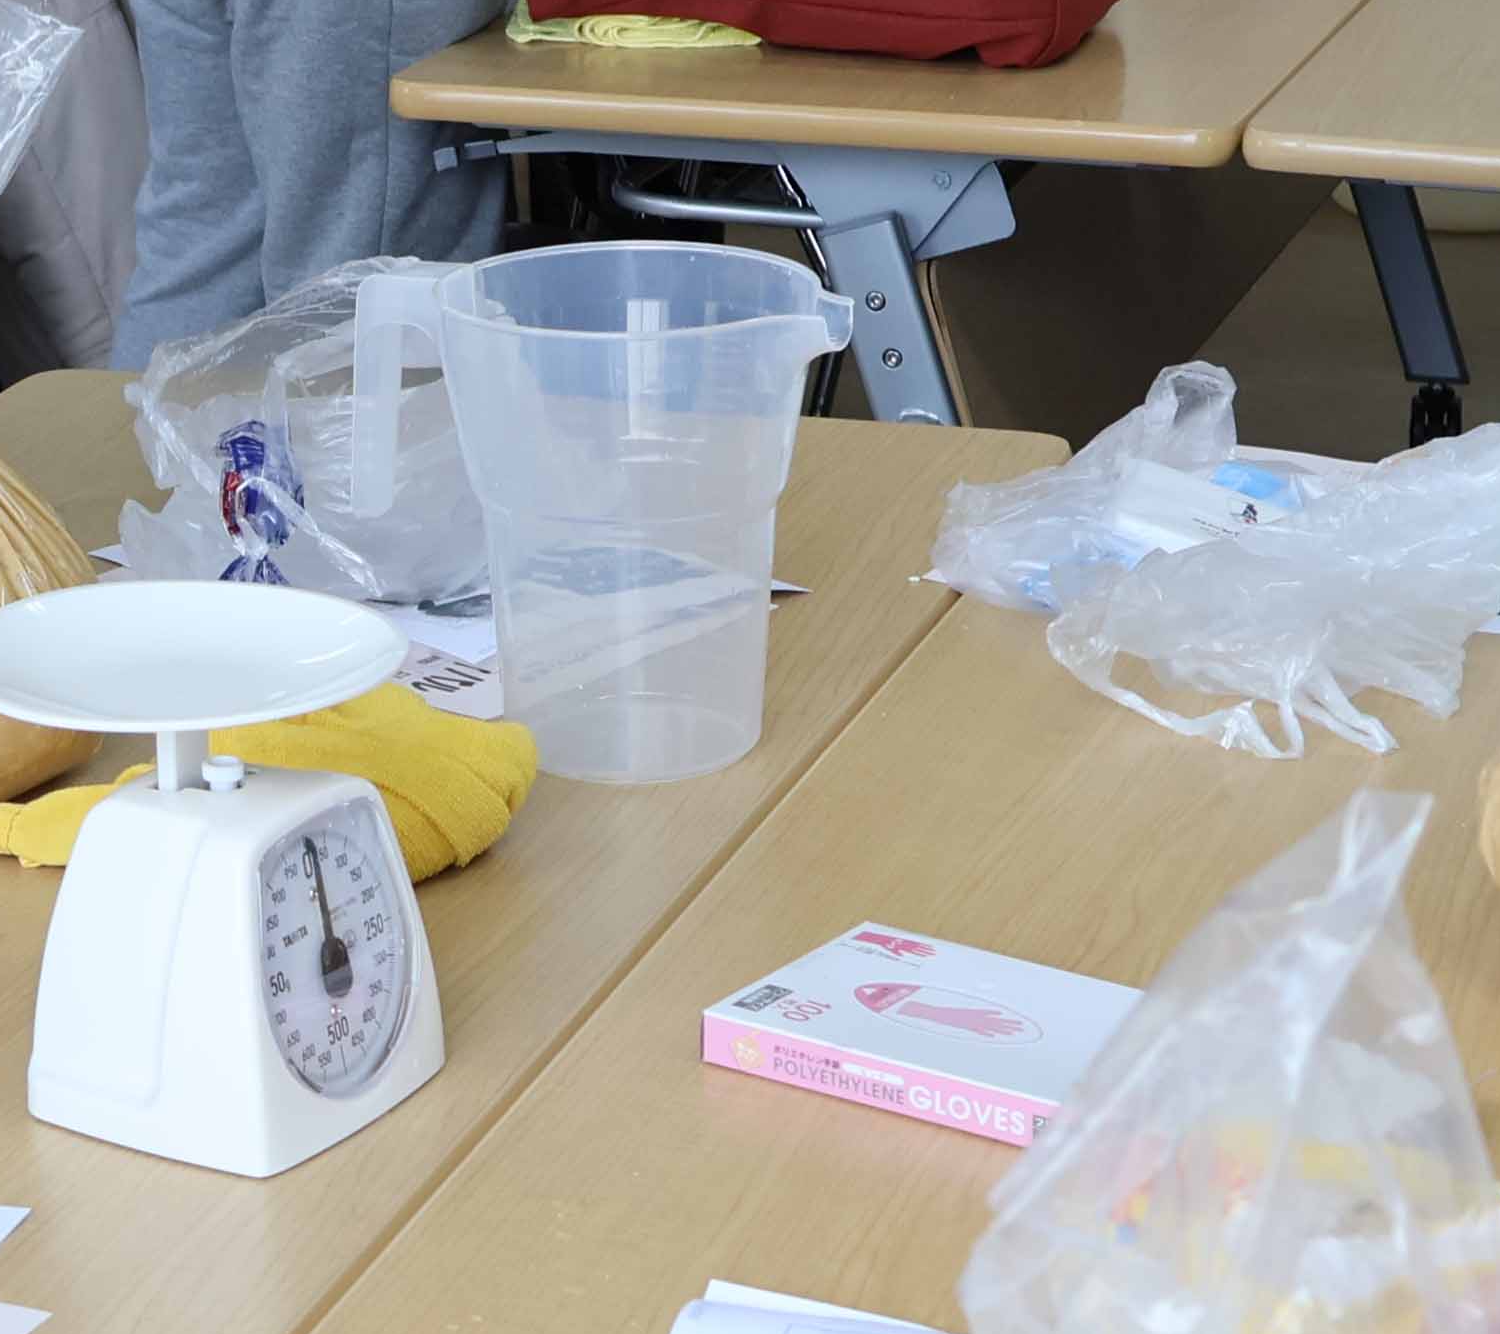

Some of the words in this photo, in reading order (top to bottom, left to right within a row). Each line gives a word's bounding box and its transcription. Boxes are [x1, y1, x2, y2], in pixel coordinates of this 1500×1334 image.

[302, 849, 314, 879] 0
[364, 913, 384, 941] 250
[269, 970, 291, 997] 50g
[783, 999, 832, 1024] 100
[327, 1015, 350, 1045] 500
[773, 1056, 904, 1105] POLYETHYLENE
[908, 1085, 1025, 1136] GLOVES
